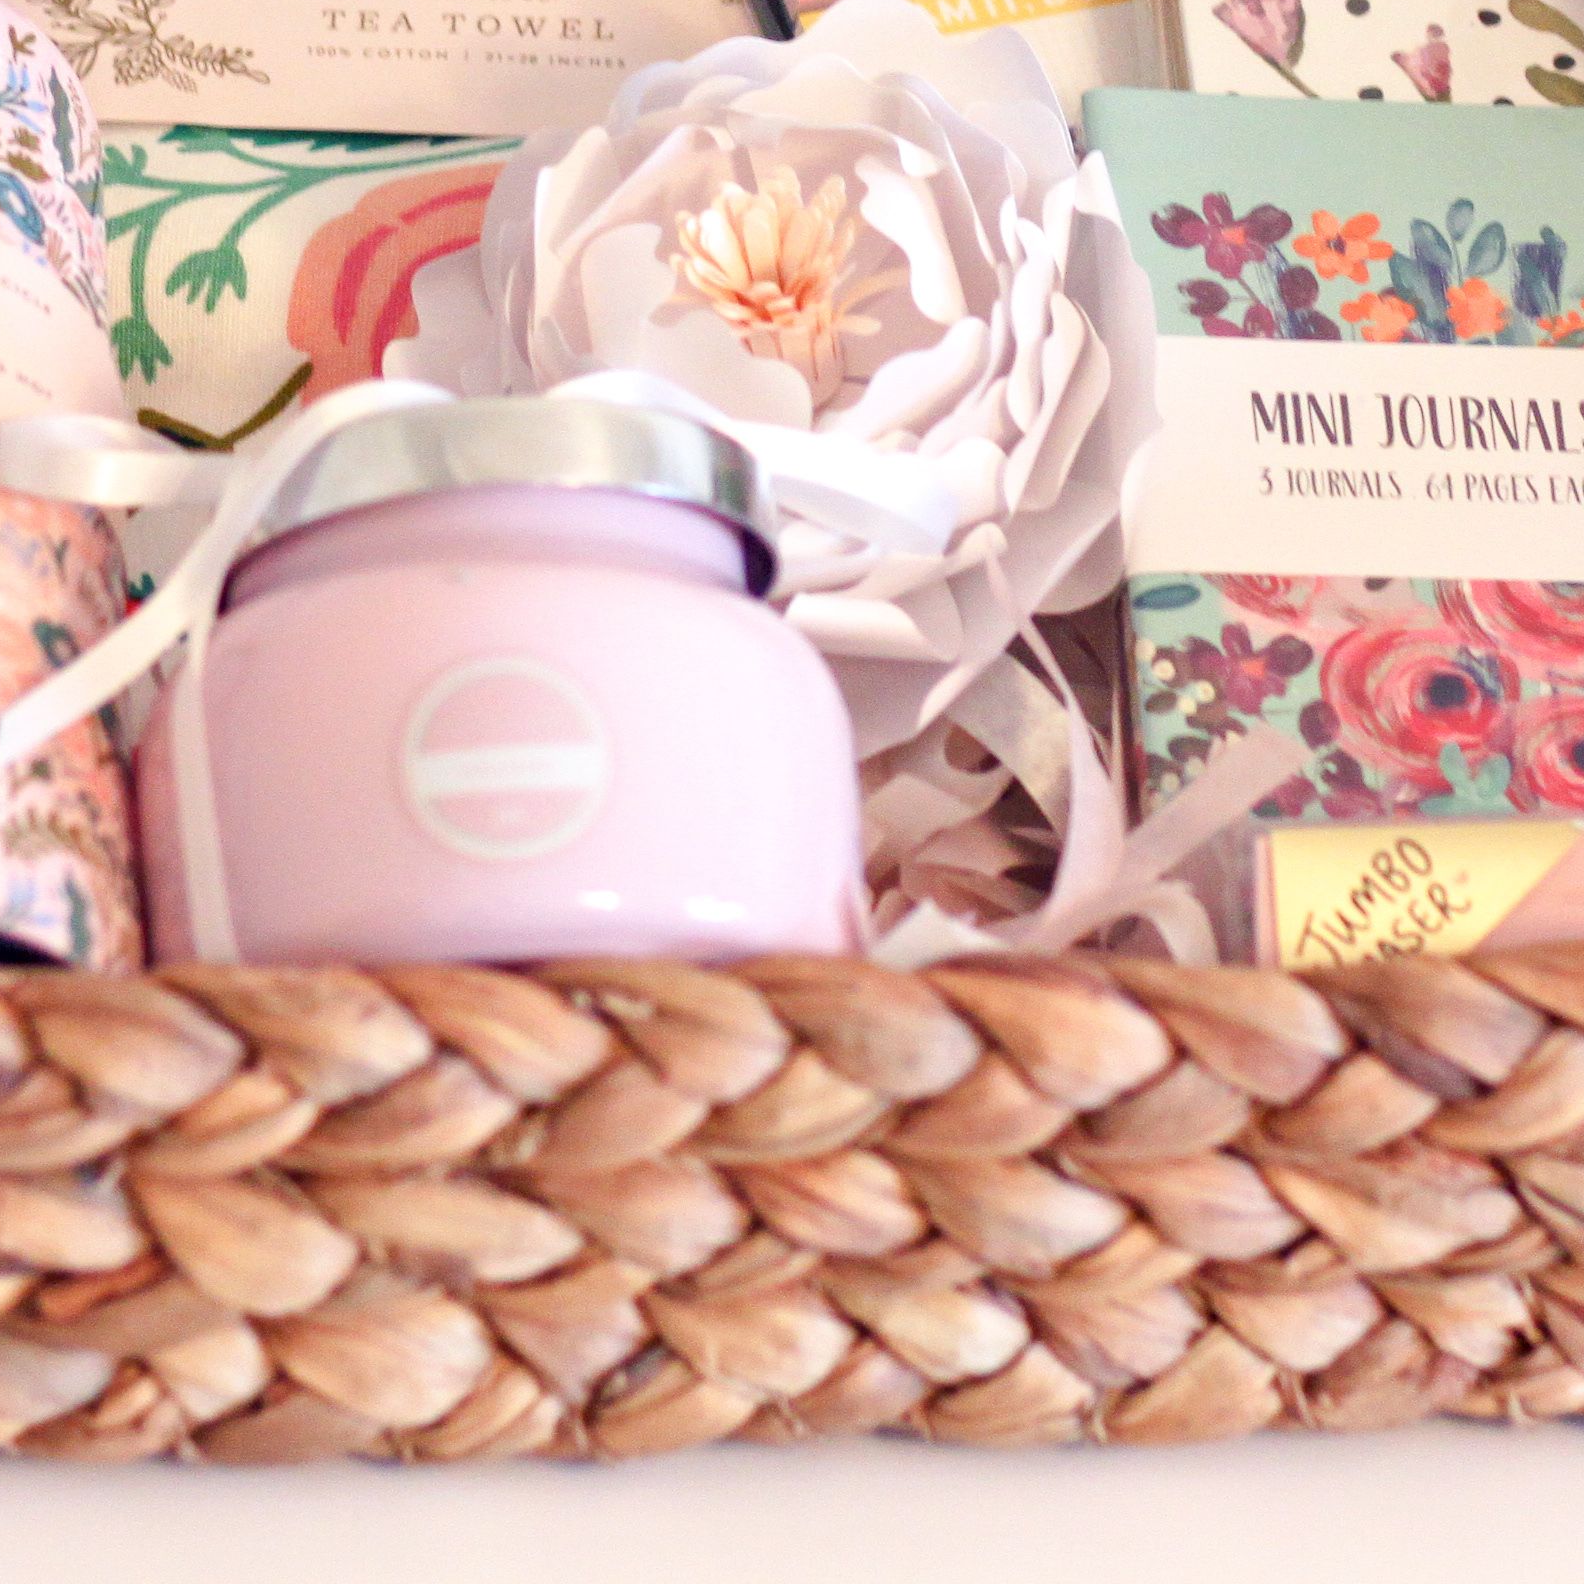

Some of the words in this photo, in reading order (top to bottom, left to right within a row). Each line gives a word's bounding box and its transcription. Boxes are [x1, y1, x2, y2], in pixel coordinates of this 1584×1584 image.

[320, 8, 415, 34] TEA
[441, 11, 615, 43] TOWEL
[362, 46, 449, 62] COTTON
[1249, 389, 1356, 449] MINI
[1257, 467, 1275, 498] 3
[1283, 467, 1403, 501] JOURNALS
[1463, 472, 1541, 505] PAGES
[1294, 836, 1434, 966] JUMBO
